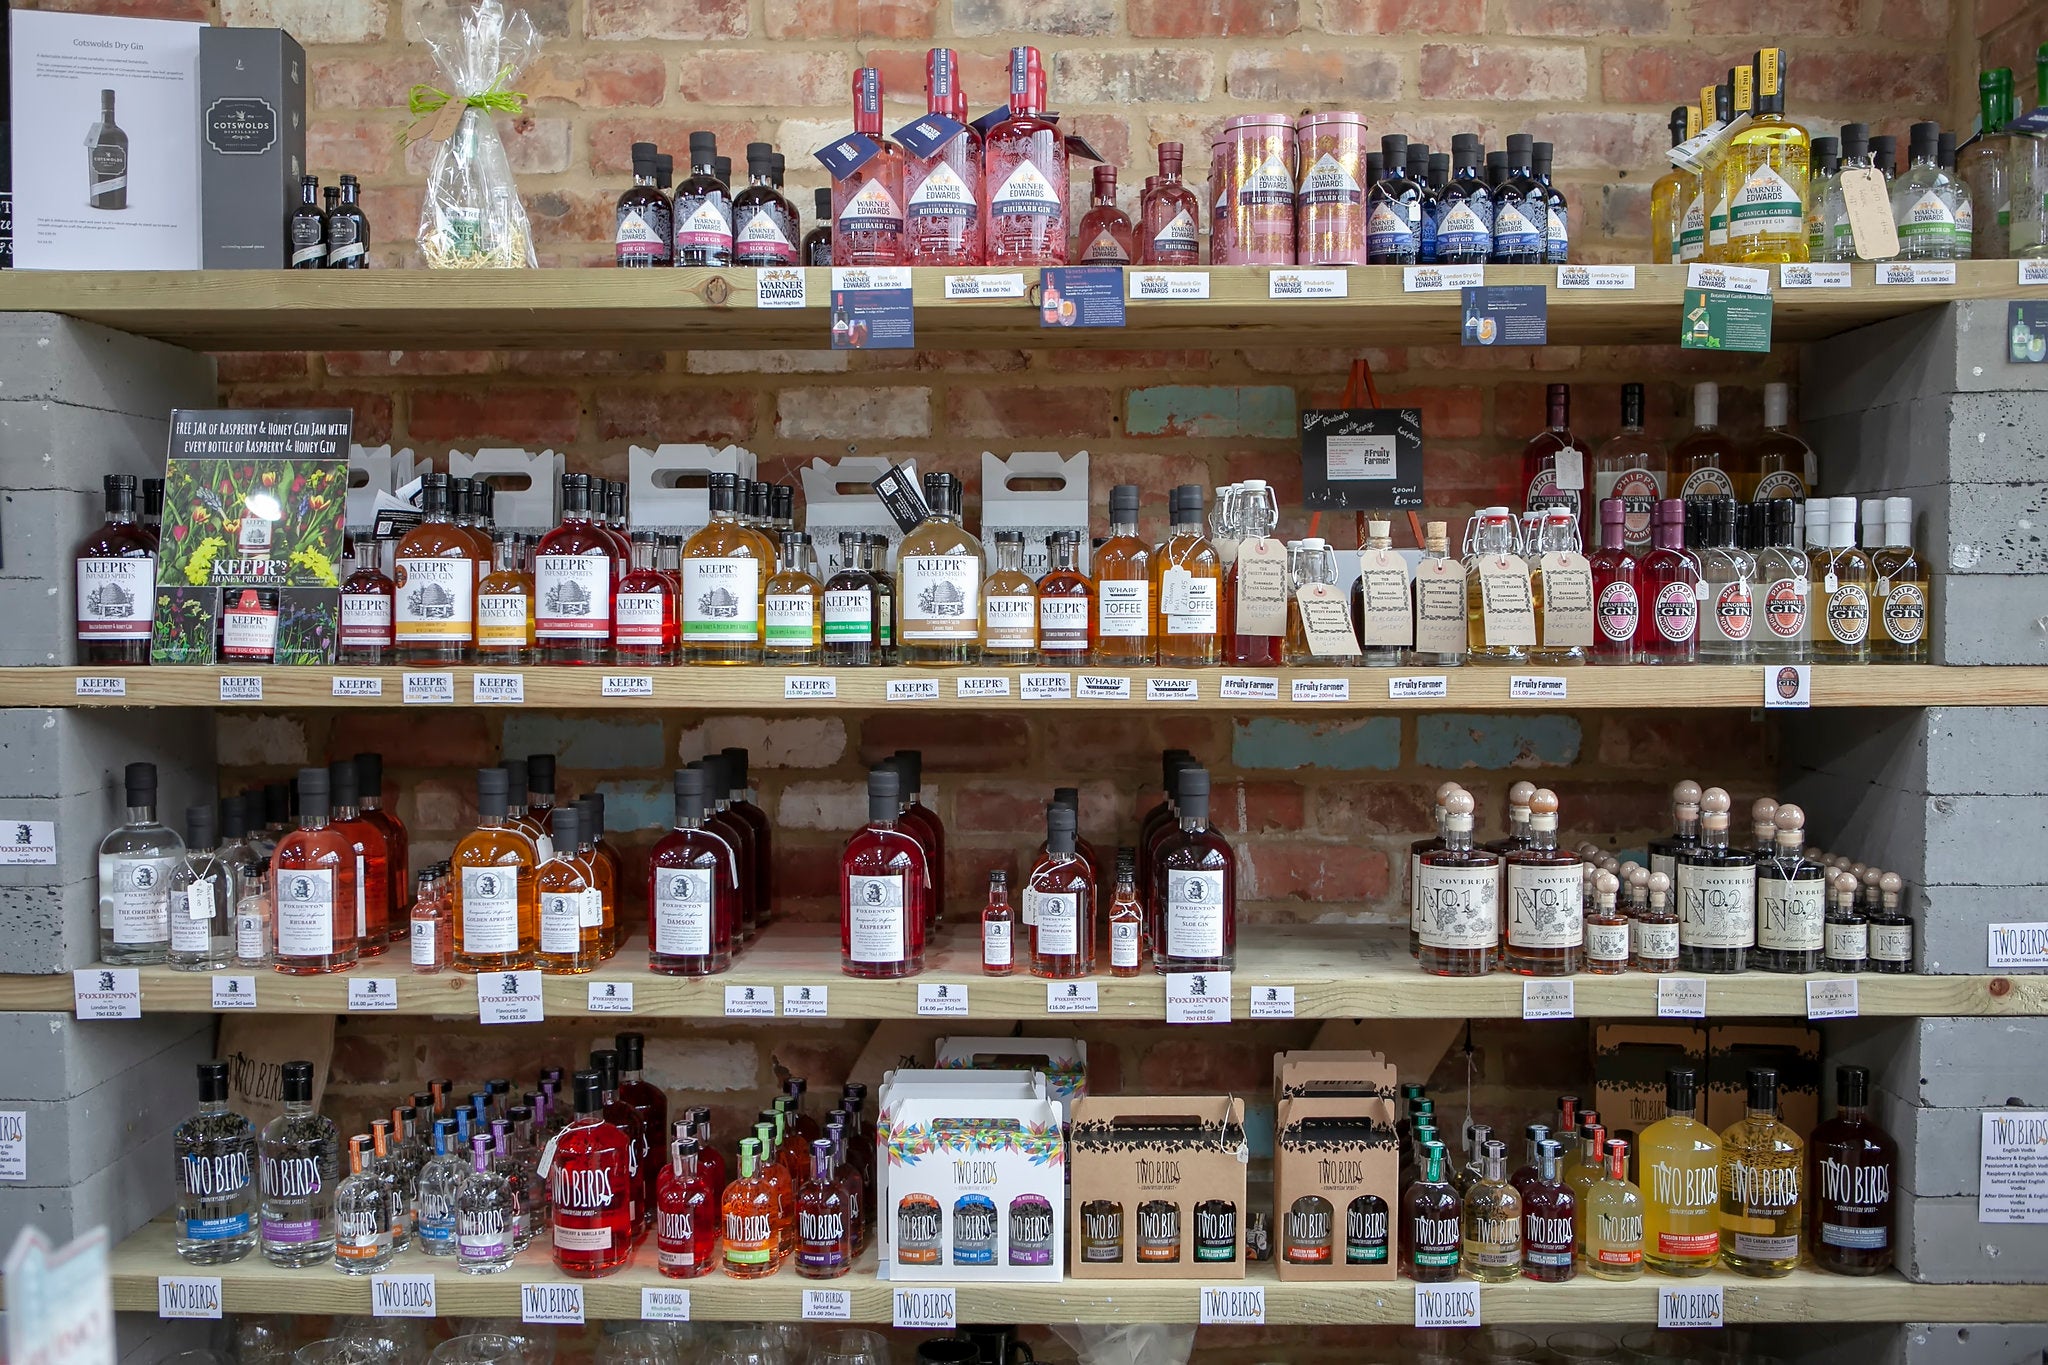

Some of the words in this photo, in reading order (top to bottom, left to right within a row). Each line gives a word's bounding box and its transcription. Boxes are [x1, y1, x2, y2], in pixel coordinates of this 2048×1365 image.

[73, 38, 112, 49] Cotswolds
[115, 40, 128, 51] Dry
[130, 42, 144, 50] Gin
[214, 121, 269, 130] COTSWOLDS
[926, 184, 960, 192] WARNER
[1746, 186, 1782, 194] WARNER
[1746, 193, 1782, 202] EDWARDS
[1737, 209, 1767, 218] BOTANICAL
[1913, 208, 1943, 216] WARNER
[760, 290, 803, 298] EDWARDS
[176, 422, 191, 435] FREE
[193, 422, 206, 435] JAR
[259, 421, 267, 434] &
[185, 439, 206, 452] EVERY
[208, 440, 233, 453] BOTTLE
[285, 439, 292, 452] &
[1370, 449, 1390, 457] Fruity
[211, 575, 242, 583] HONEY
[243, 574, 286, 583] PRODUCTS
[1605, 585, 1633, 598] PHIPPS
[1835, 588, 1864, 602] PHIPPS
[1105, 603, 1141, 614] TOFFEE
[1603, 607, 1633, 616] GIN
[1833, 610, 1864, 618] GIN
[1601, 616, 1635, 636] NORTHAMPTON
[1832, 619, 1866, 639] NORTHAMPTON
[1084, 677, 1123, 686] WHARF
[1399, 679, 1418, 690] Fruity
[1992, 930, 2018, 955] TWO
[1991, 1120, 2016, 1145] TWO
[182, 1155, 212, 1194] TWO
[215, 1150, 251, 1192] BIRDS
[952, 1160, 972, 1184] TWO
[973, 1159, 998, 1184] BIRDS
[1135, 1161, 1155, 1184] TWO
[1157, 1160, 1182, 1184] BIRDS
[1318, 1160, 1337, 1184] TWO
[1338, 1160, 1363, 1184] BIRDS
[1652, 1165, 1682, 1205] TWO
[1686, 1165, 1718, 1204] BIRDS
[1820, 1161, 1851, 1203] TWO
[1855, 1163, 1890, 1203] BIRDS
[162, 1283, 187, 1309] TWO
[189, 1284, 218, 1310] BIRDS
[523, 1287, 549, 1312] TWO
[550, 1287, 580, 1313] BIRDS
[1418, 1292, 1444, 1317] TWO
[1445, 1290, 1475, 1318] BIRDS
